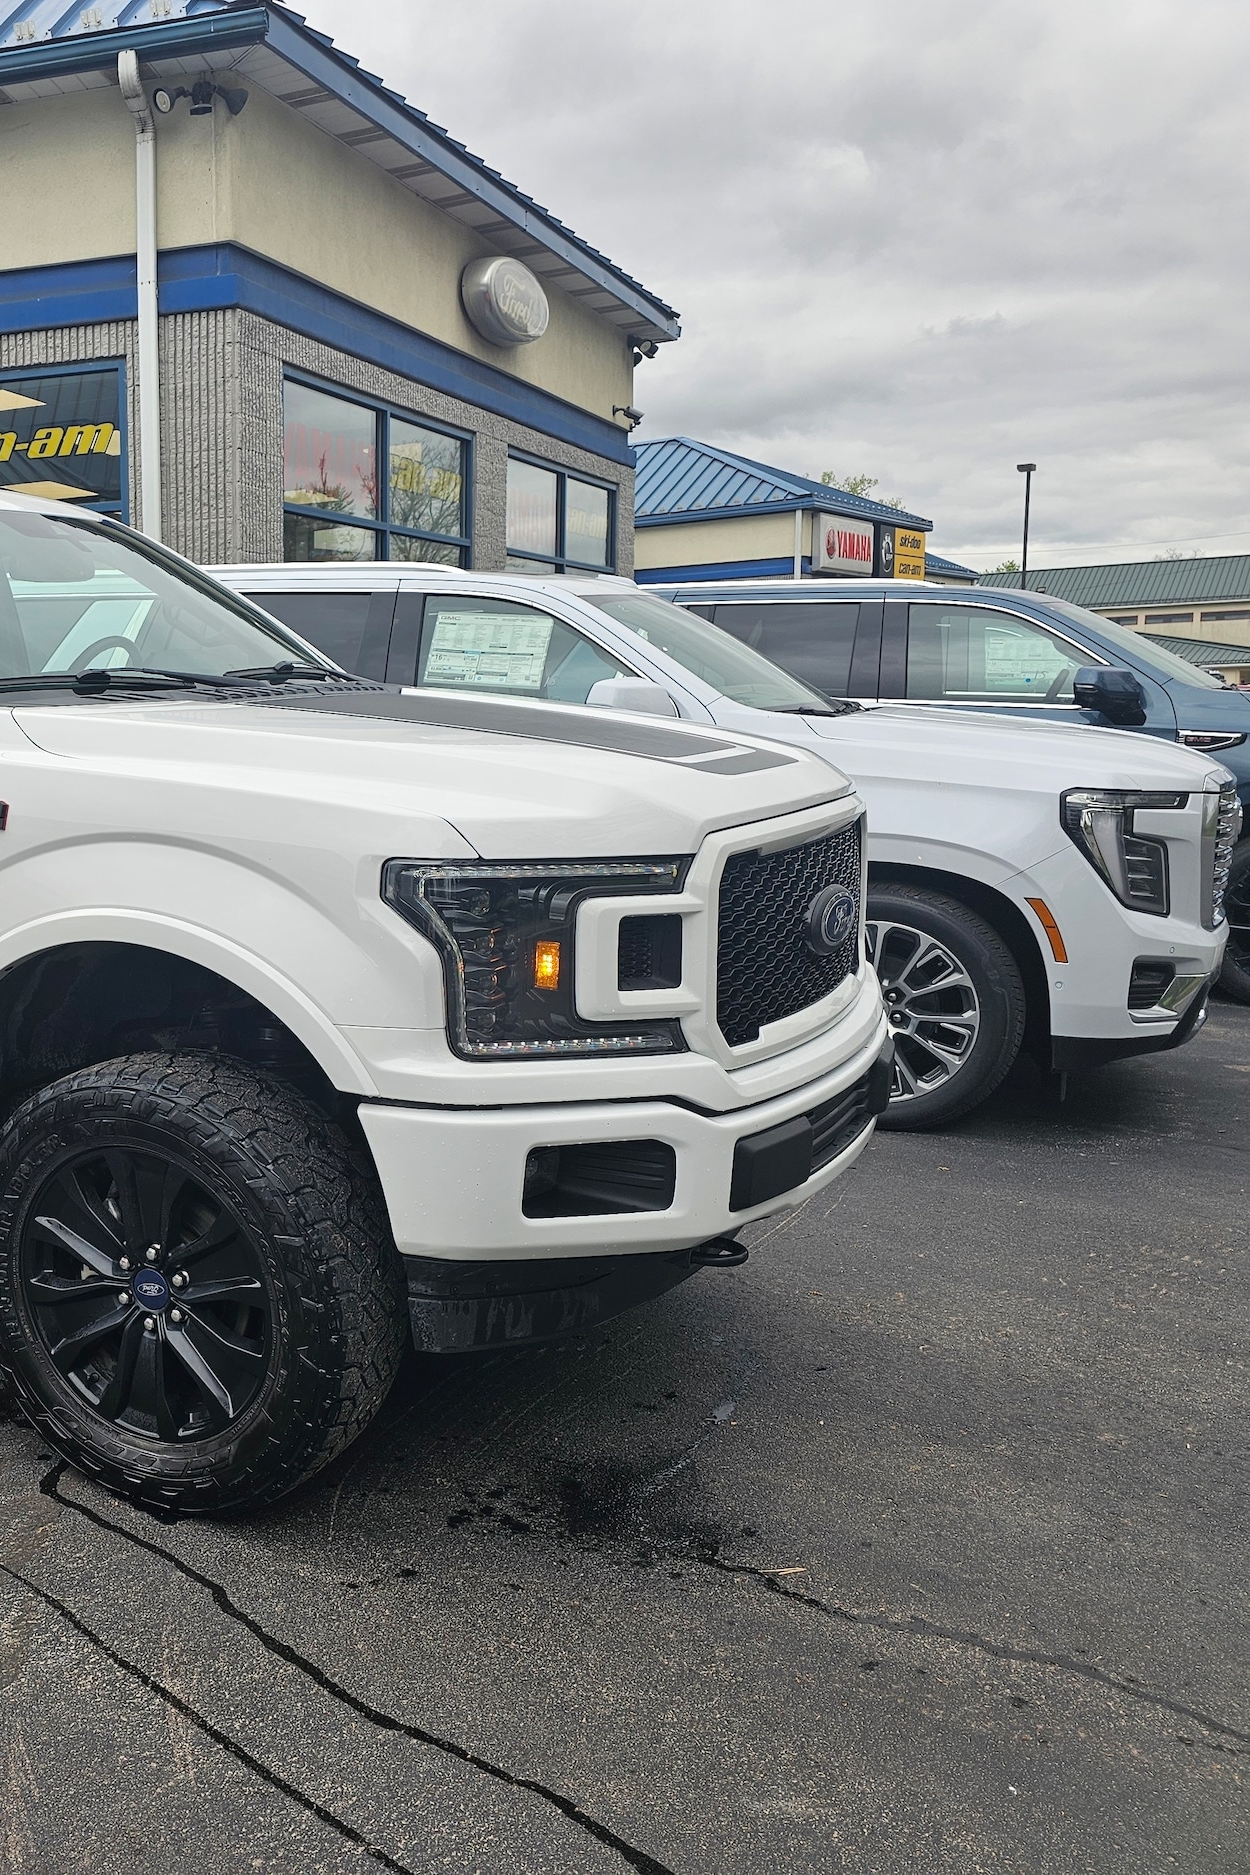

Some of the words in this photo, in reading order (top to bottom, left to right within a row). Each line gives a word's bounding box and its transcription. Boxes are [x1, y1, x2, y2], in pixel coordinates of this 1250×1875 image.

[837, 530, 871, 562] YAMAHA
[900, 534, 921, 550] ski-doo
[898, 563, 921, 576] can-am
